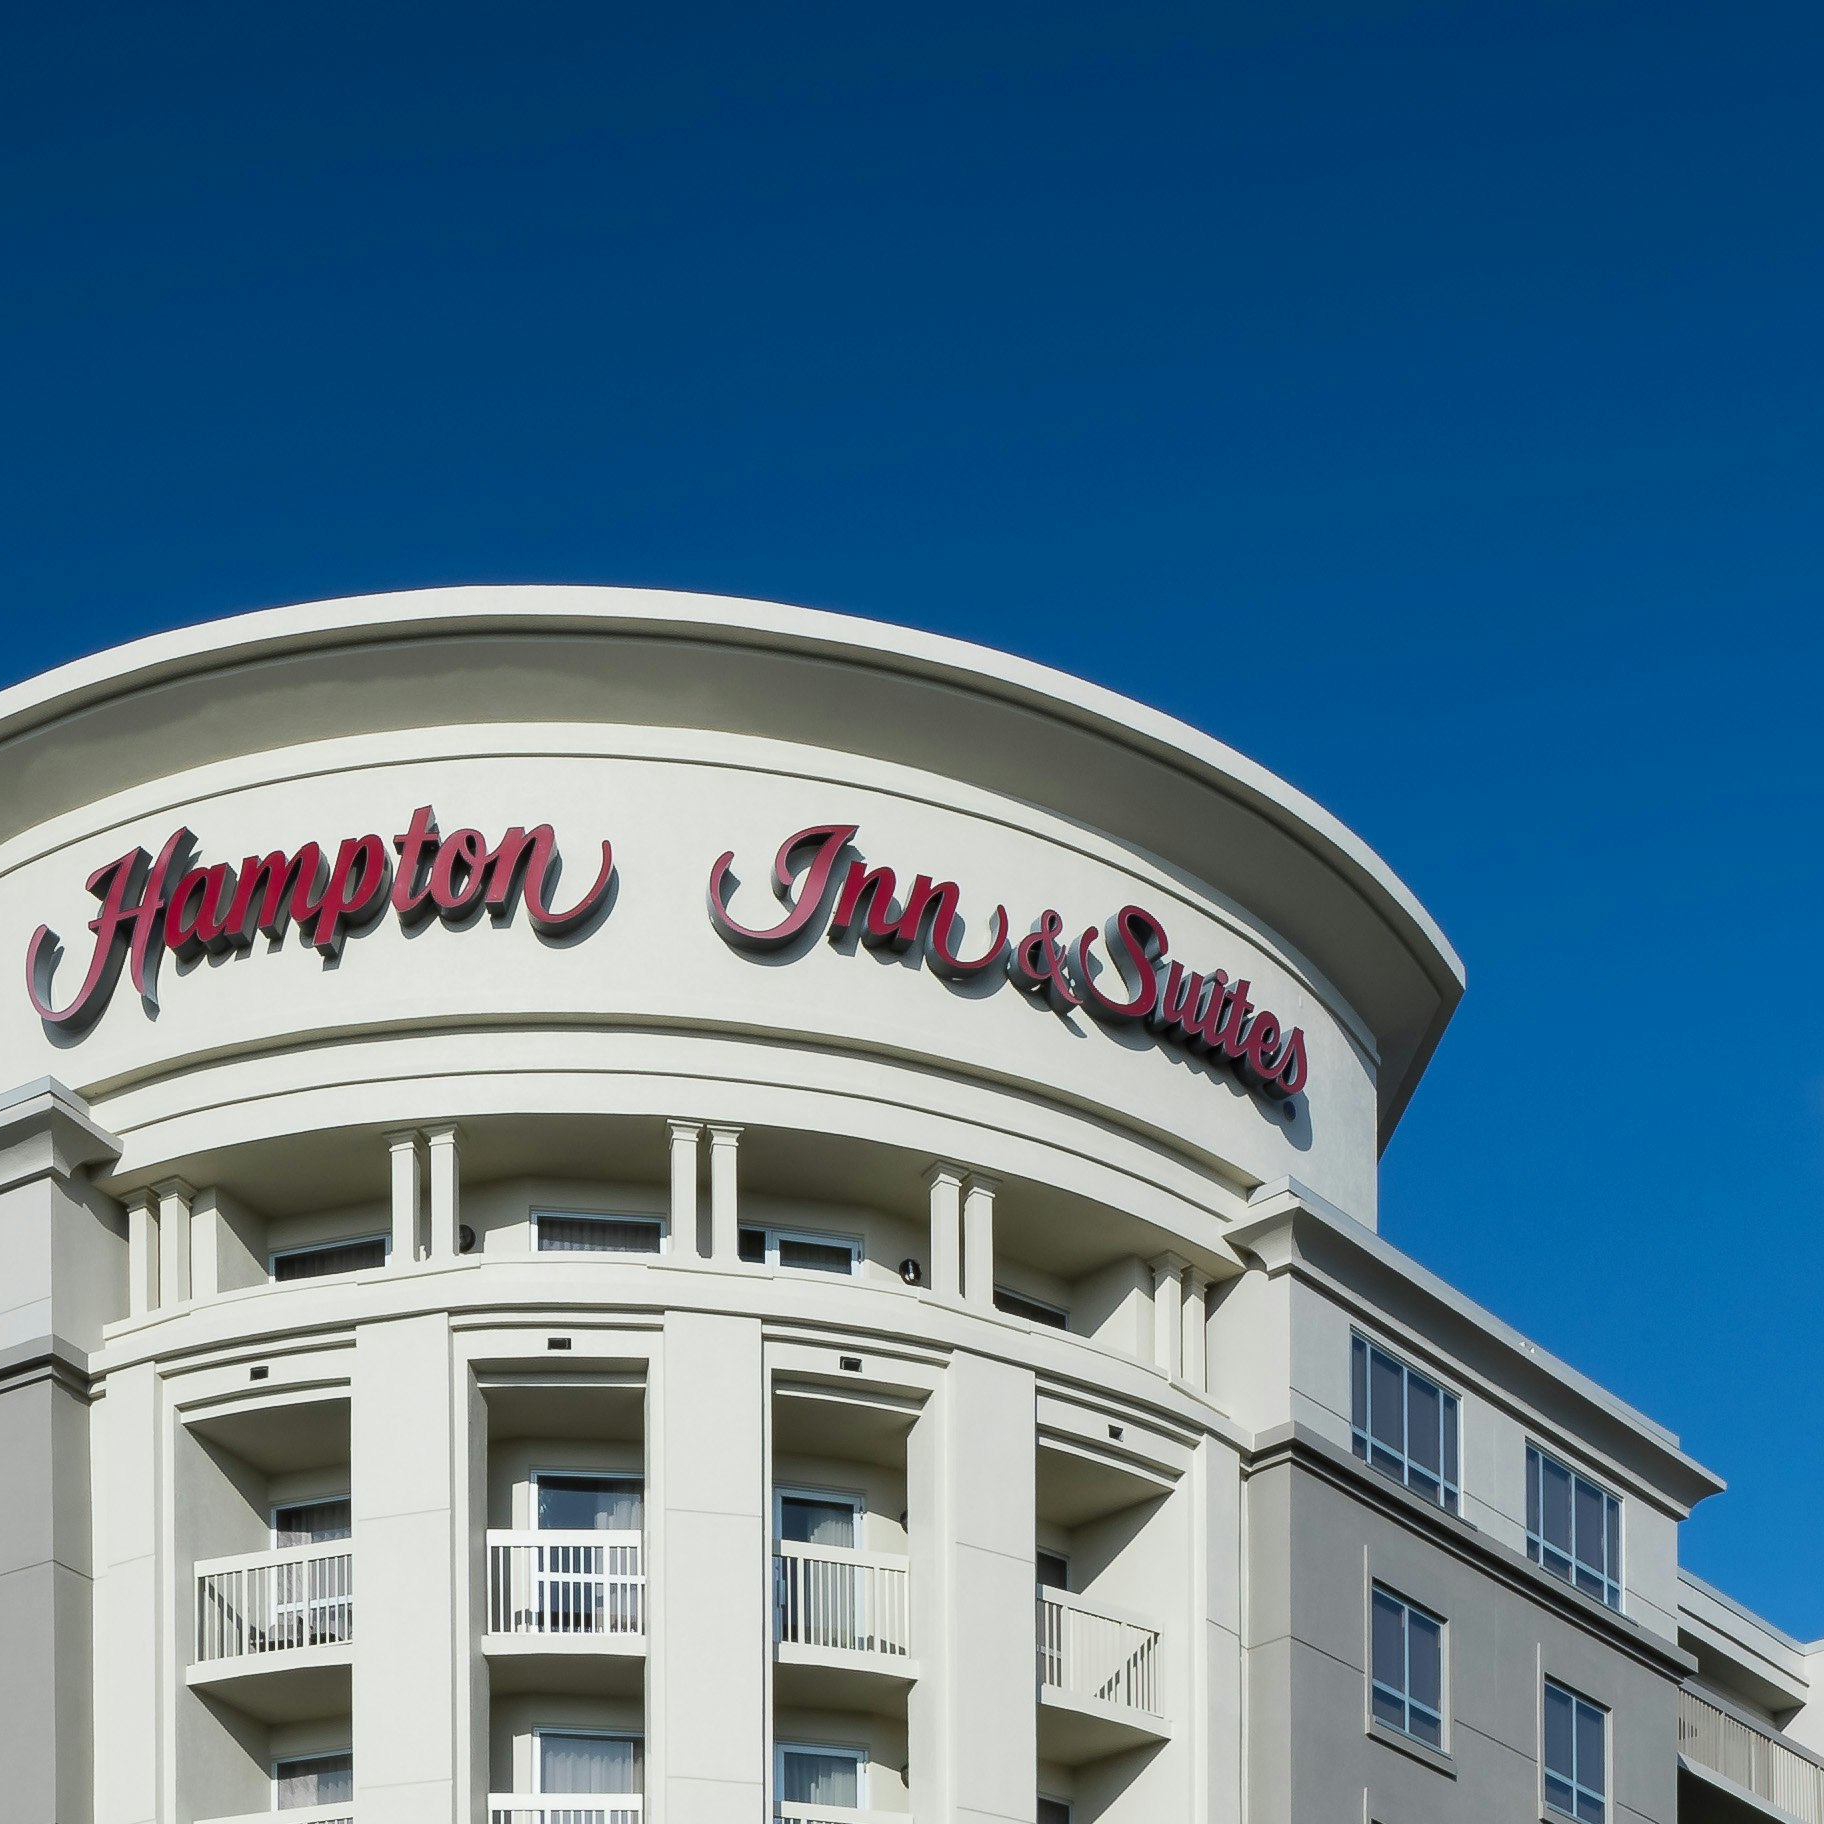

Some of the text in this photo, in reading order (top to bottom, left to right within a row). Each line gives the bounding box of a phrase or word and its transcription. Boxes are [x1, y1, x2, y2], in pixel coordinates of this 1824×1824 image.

[26, 804, 1307, 1096] Hampton Inn & Suites
